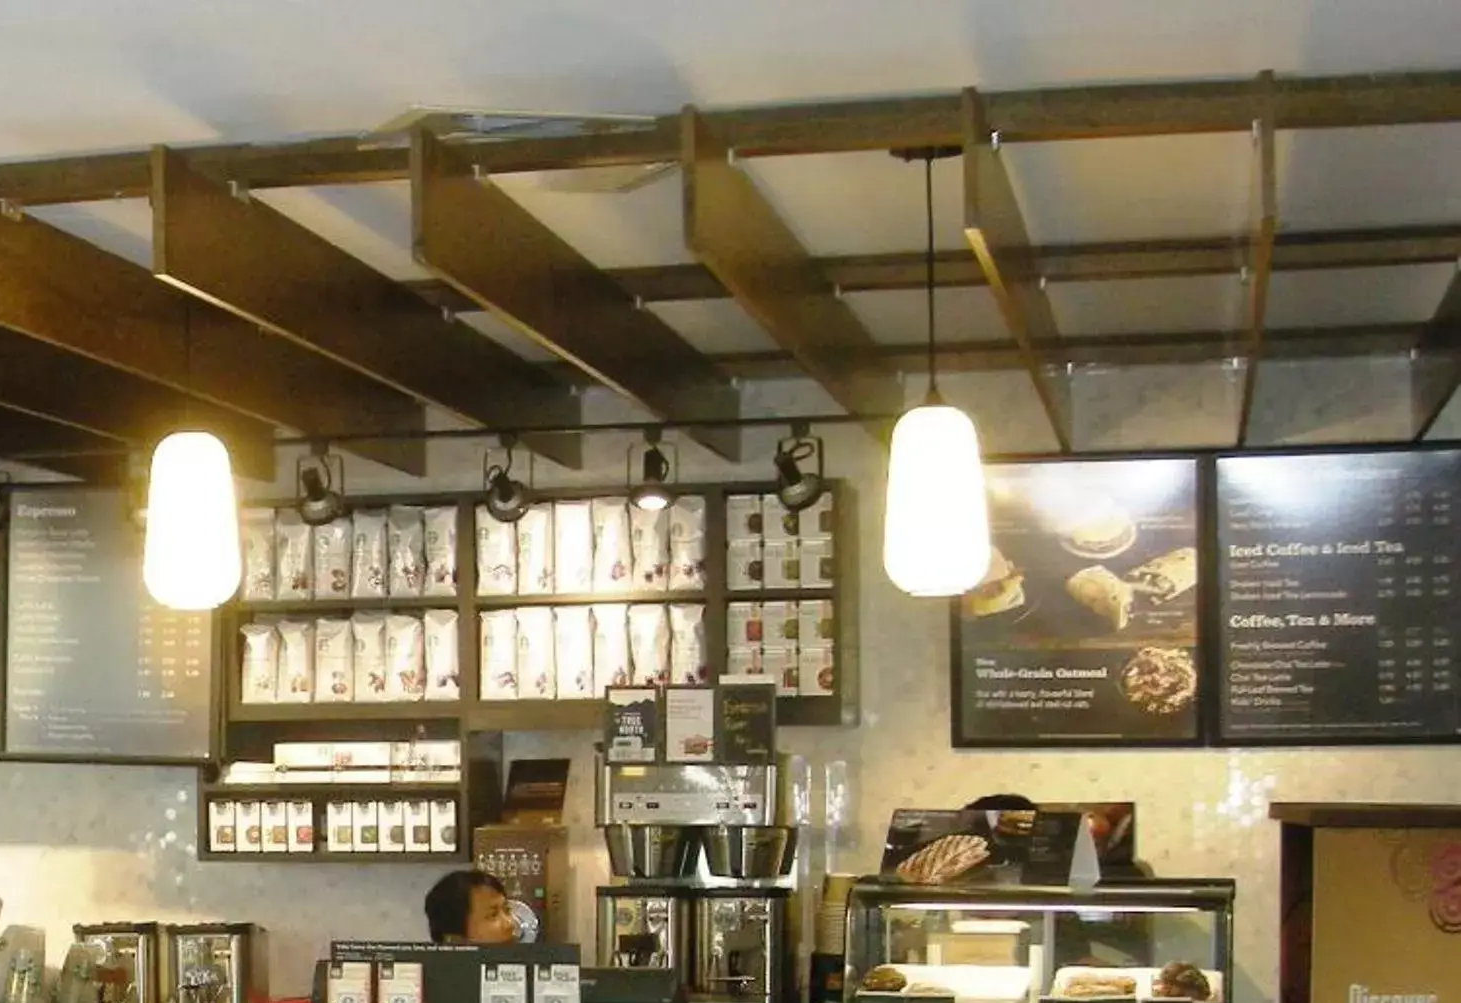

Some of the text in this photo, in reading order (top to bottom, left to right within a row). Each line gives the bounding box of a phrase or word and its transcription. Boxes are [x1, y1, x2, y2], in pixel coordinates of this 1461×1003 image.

[1266, 542, 1319, 556] Coffee
[1373, 540, 1404, 553] Tea
[1286, 614, 1316, 627] Tea
[1333, 612, 1377, 626] More
[1056, 666, 1108, 679] Oatmeal
